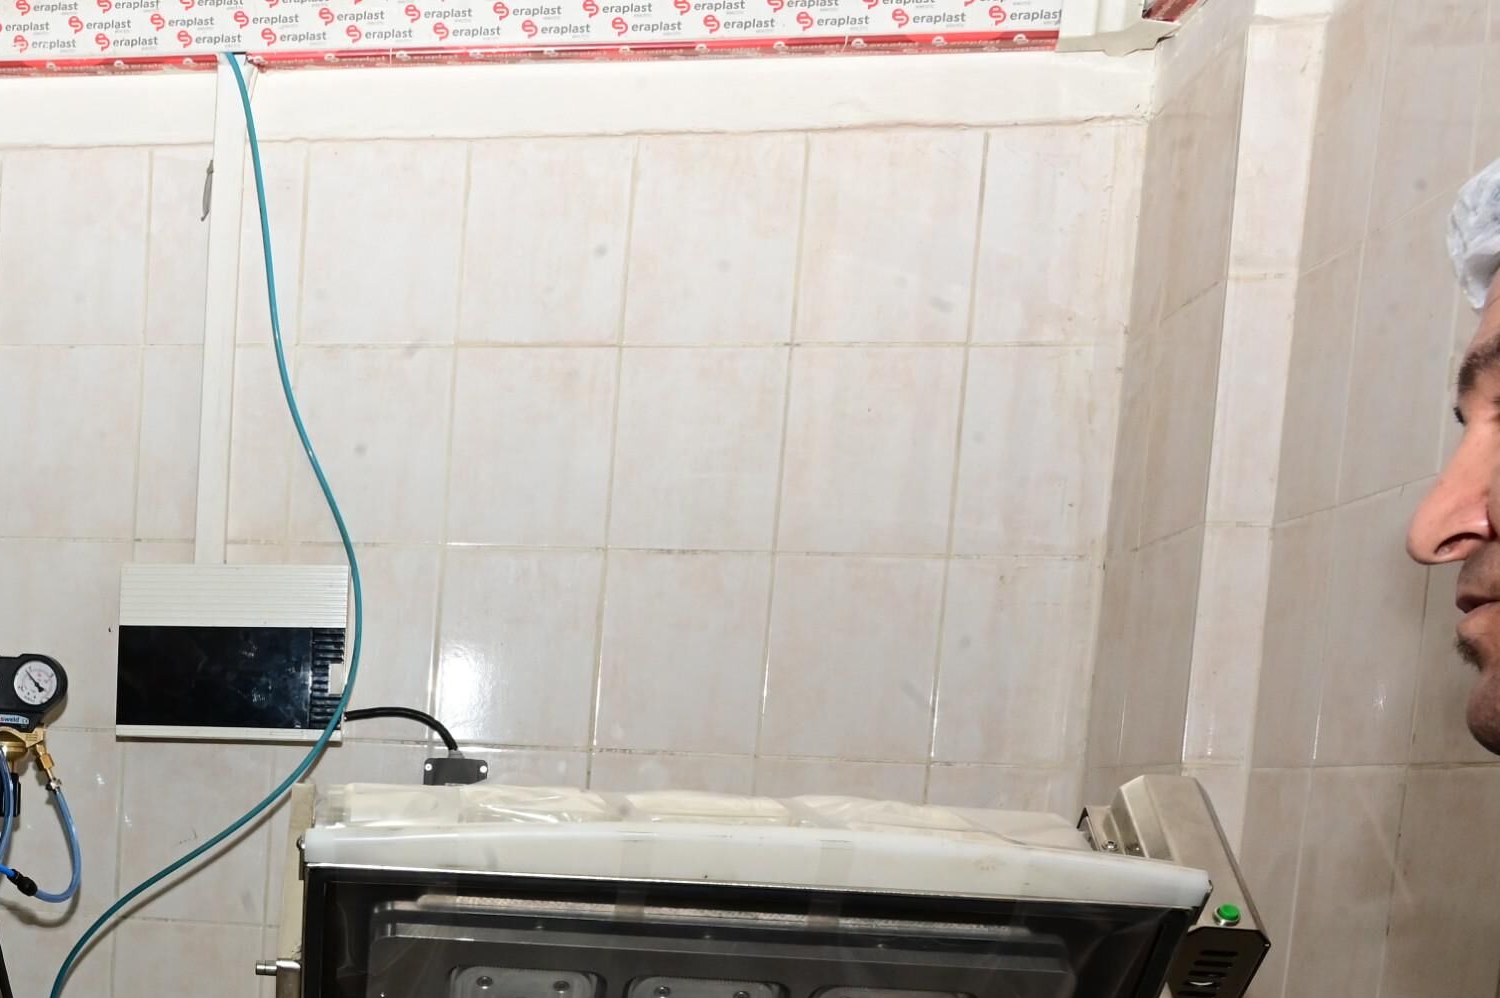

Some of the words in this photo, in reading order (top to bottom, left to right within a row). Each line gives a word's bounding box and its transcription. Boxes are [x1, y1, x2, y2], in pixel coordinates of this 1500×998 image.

[33, 2, 78, 12] eraplast
[115, 0, 160, 10] eraplast
[602, 3, 652, 14] eraplast
[694, 0, 745, 12] eraplast
[337, 11, 384, 22] eraplast
[424, 8, 472, 19] eraplast
[513, 6, 561, 17] eraplast
[168, 17, 214, 28] eraplast
[252, 14, 299, 25] eraplast
[724, 18, 775, 30] eraplast
[817, 16, 869, 27] eraplast
[913, 13, 966, 24] eraplast
[5, 22, 49, 32] eraplast
[86, 20, 131, 30] eraplast
[541, 24, 590, 35] eraplast
[632, 21, 681, 32] eraplast
[280, 32, 326, 42] eraplast
[365, 29, 412, 40] eraplast
[452, 26, 500, 38] eraplast
[113, 37, 157, 48] eraplast
[195, 34, 241, 45] eraplast
